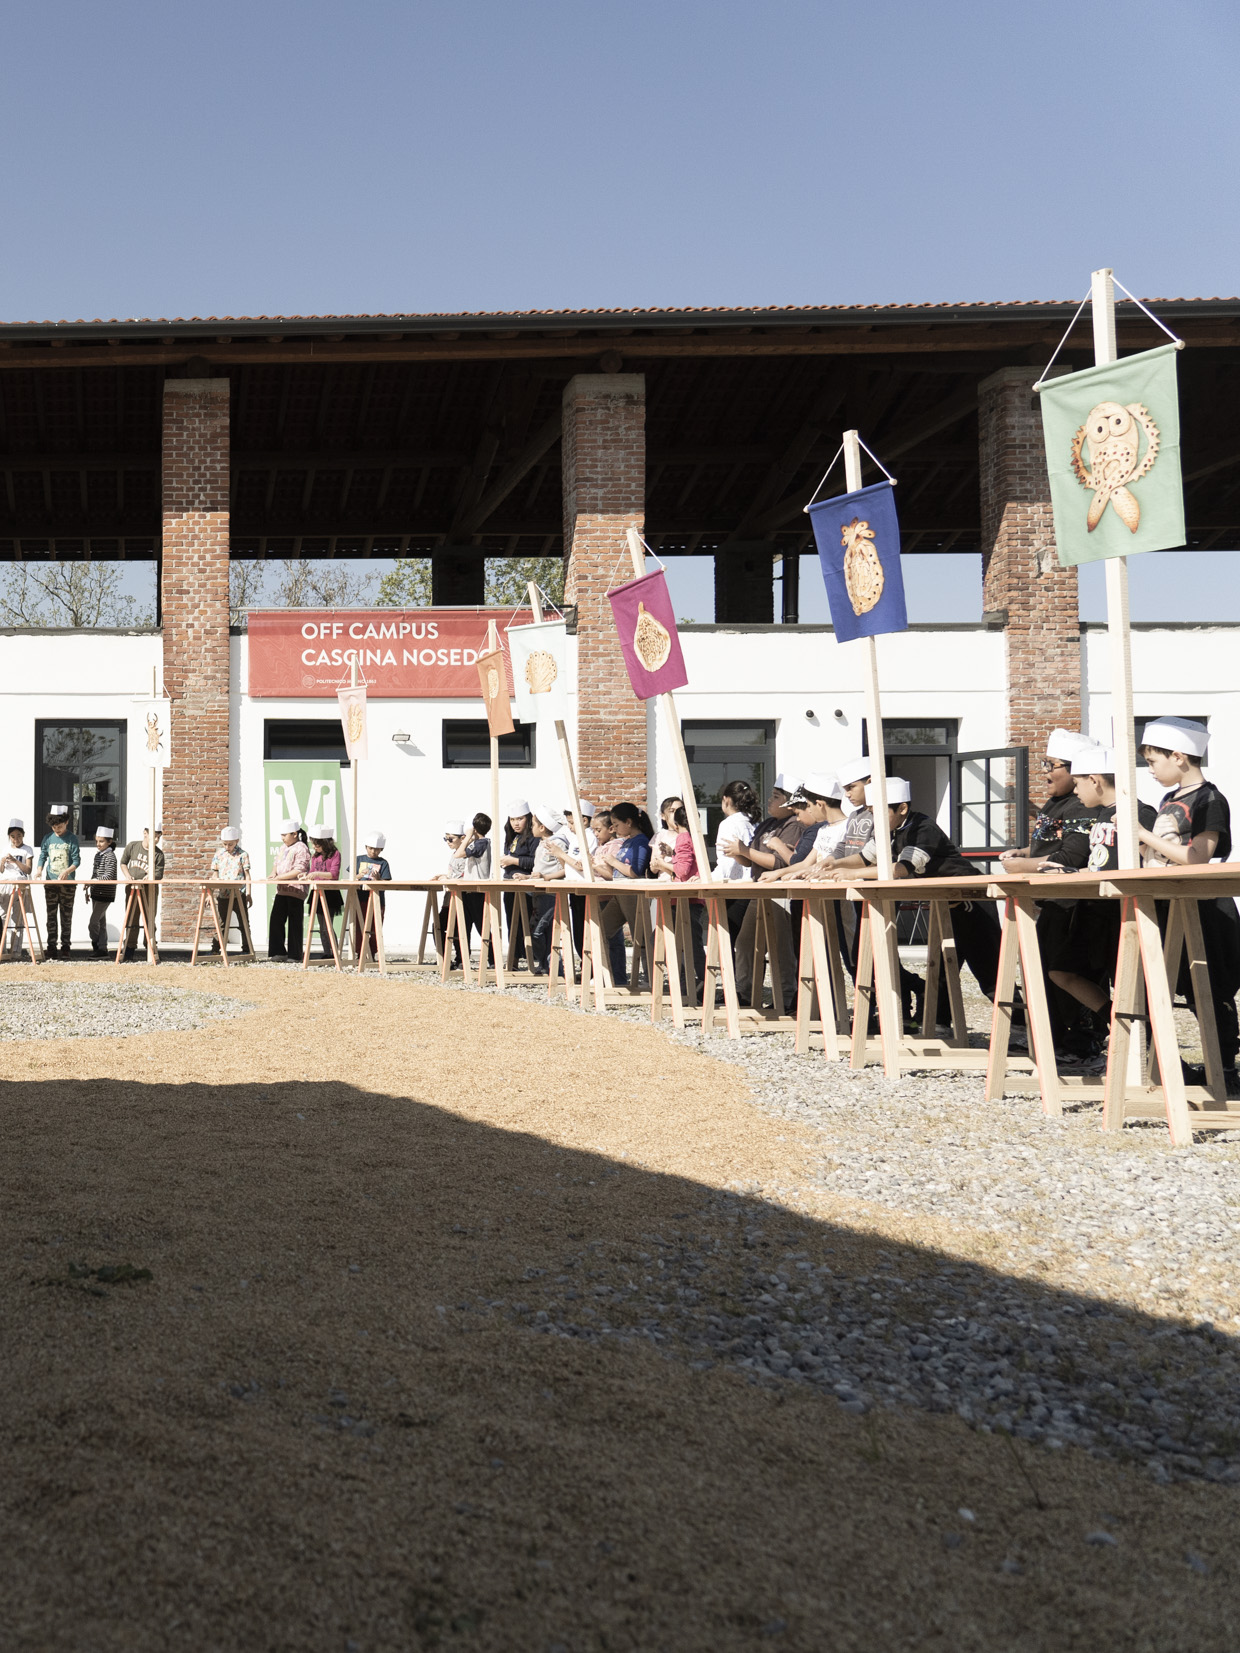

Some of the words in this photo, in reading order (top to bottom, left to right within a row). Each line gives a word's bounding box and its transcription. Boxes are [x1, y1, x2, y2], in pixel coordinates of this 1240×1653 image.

[301, 622, 344, 640] OFF
[348, 622, 439, 640] CAMPUS
[301, 648, 398, 667] CASCINA
